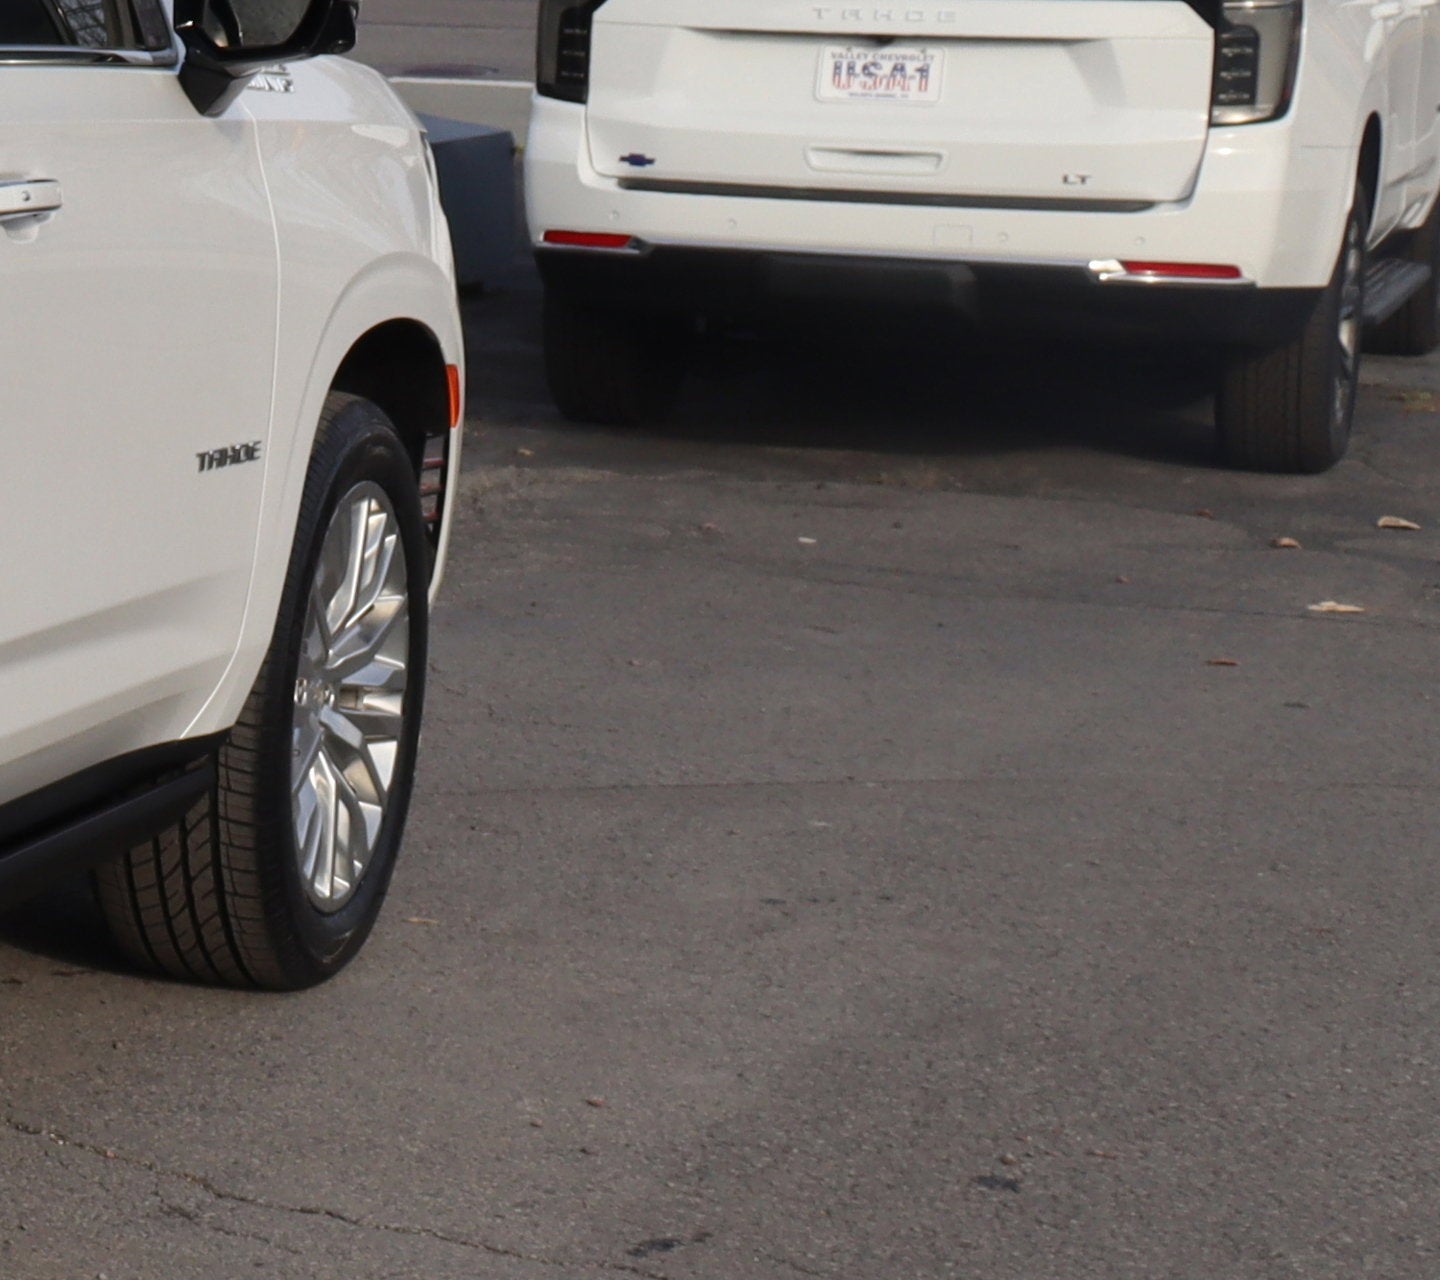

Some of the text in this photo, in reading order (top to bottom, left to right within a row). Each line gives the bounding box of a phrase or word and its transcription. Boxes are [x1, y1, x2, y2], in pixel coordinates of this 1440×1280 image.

[812, 8, 957, 22] TAHOE
[831, 51, 935, 62] VALLEY CHEVROLET
[1062, 173, 1092, 186] LT
[195, 440, 262, 473] TAHOE
